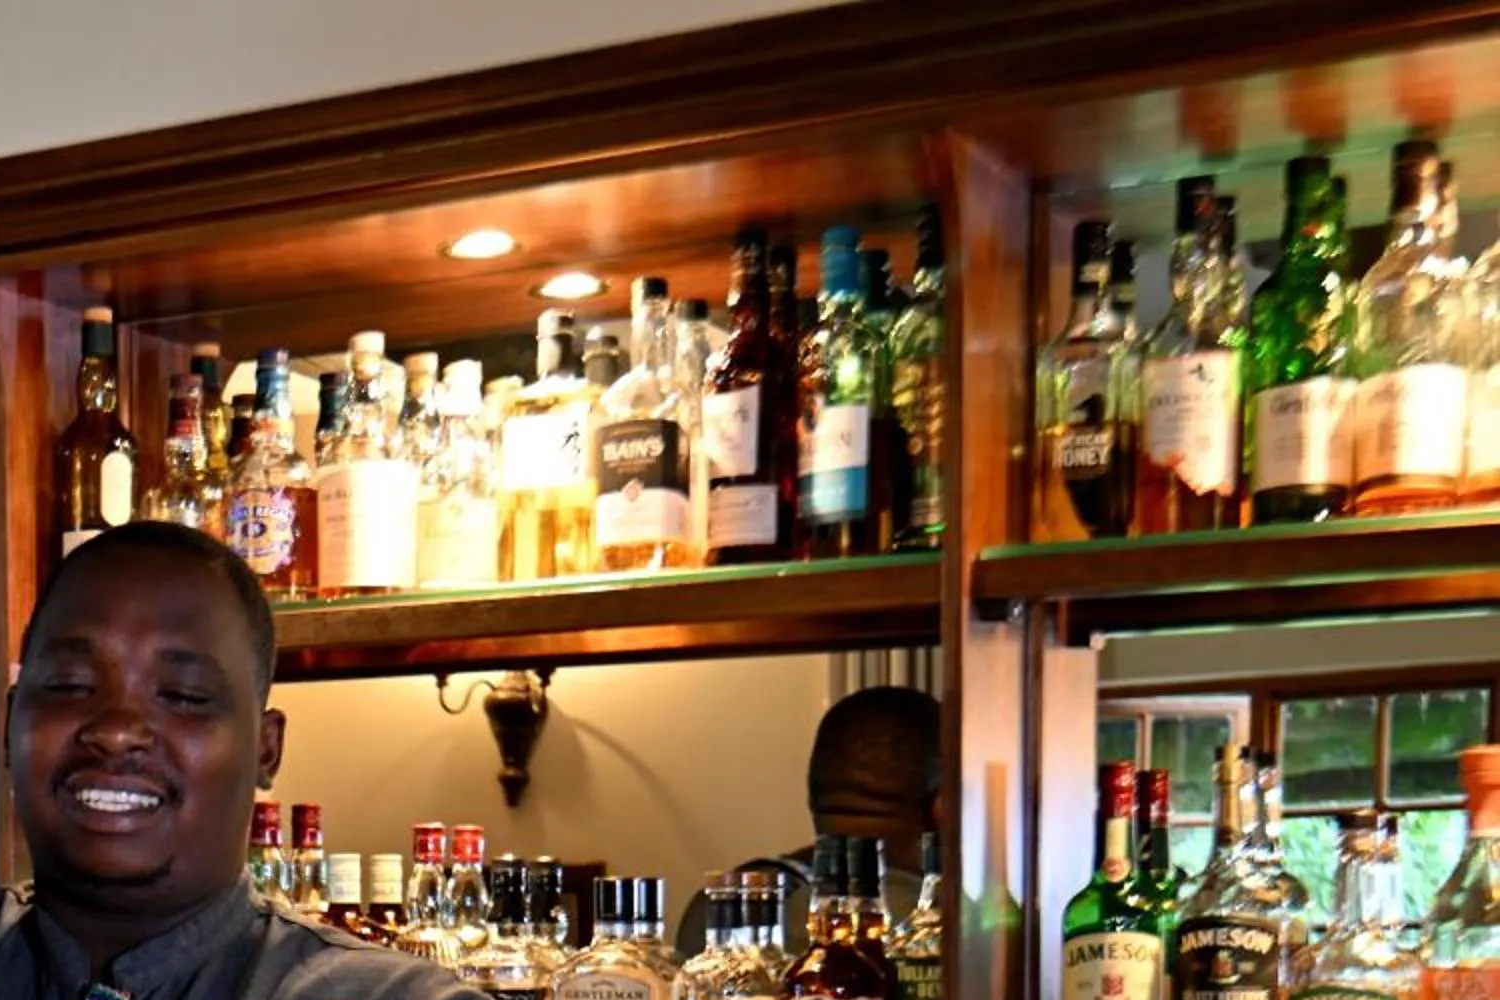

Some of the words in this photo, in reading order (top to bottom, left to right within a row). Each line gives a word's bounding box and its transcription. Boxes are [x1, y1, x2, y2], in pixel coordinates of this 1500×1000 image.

[603, 437, 665, 462] BAIN'S
[1179, 926, 1276, 955] JAMESON
[564, 990, 644, 1000] GENTLEMAN
